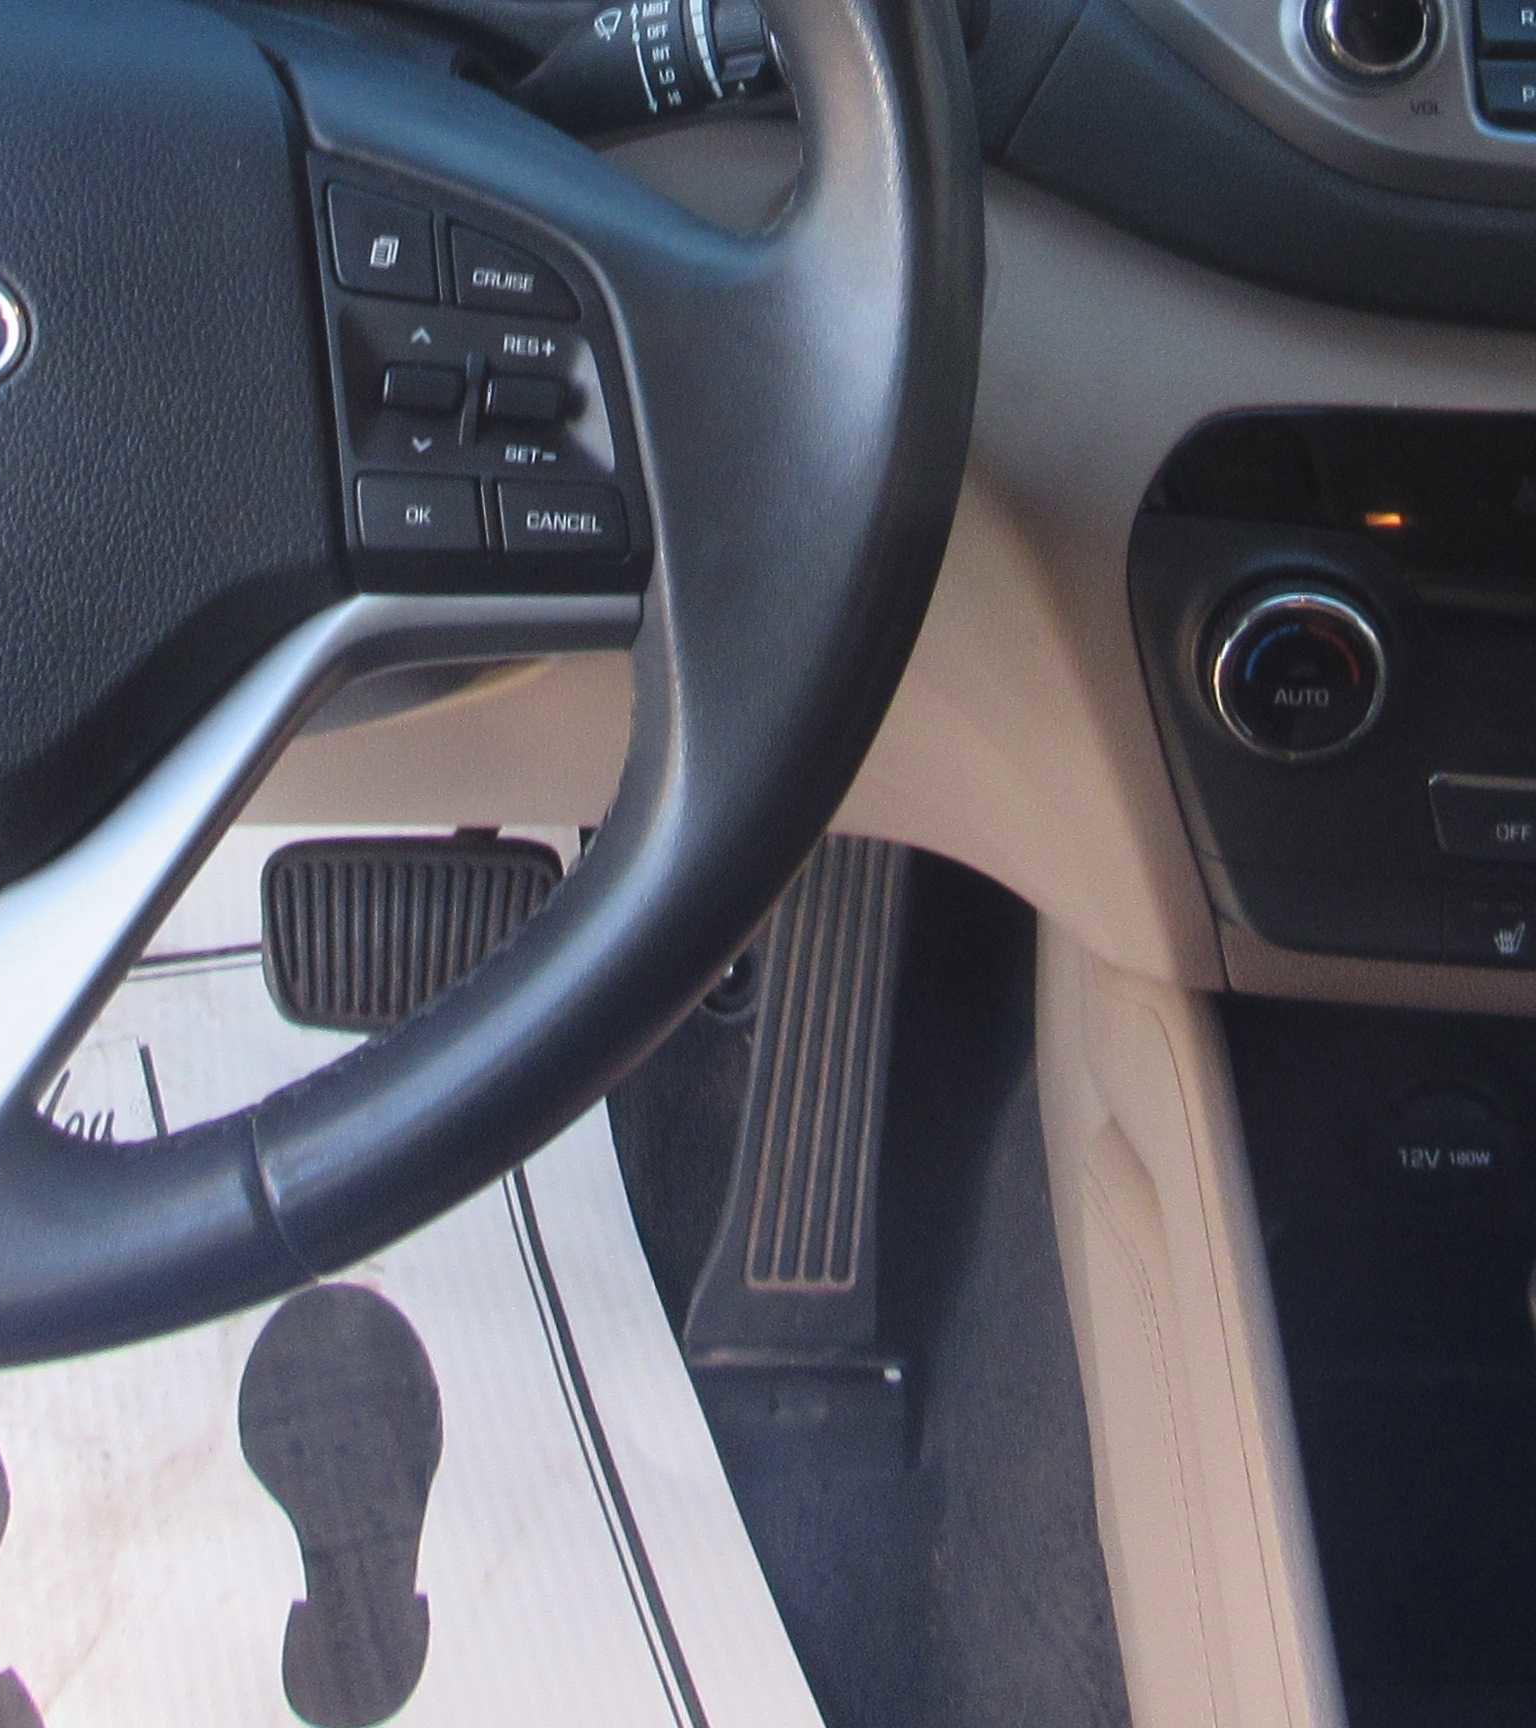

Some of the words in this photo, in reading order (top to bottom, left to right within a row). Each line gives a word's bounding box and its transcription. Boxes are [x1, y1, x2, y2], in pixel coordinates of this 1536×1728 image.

[646, 23, 669, 41] OFF
[472, 266, 535, 293] CRUISE
[405, 506, 431, 524] OK
[526, 511, 602, 534] CANCEL
[1274, 688, 1330, 707] AUTO
[1495, 822, 1532, 843] OFF
[1397, 1147, 1441, 1169] 12V
